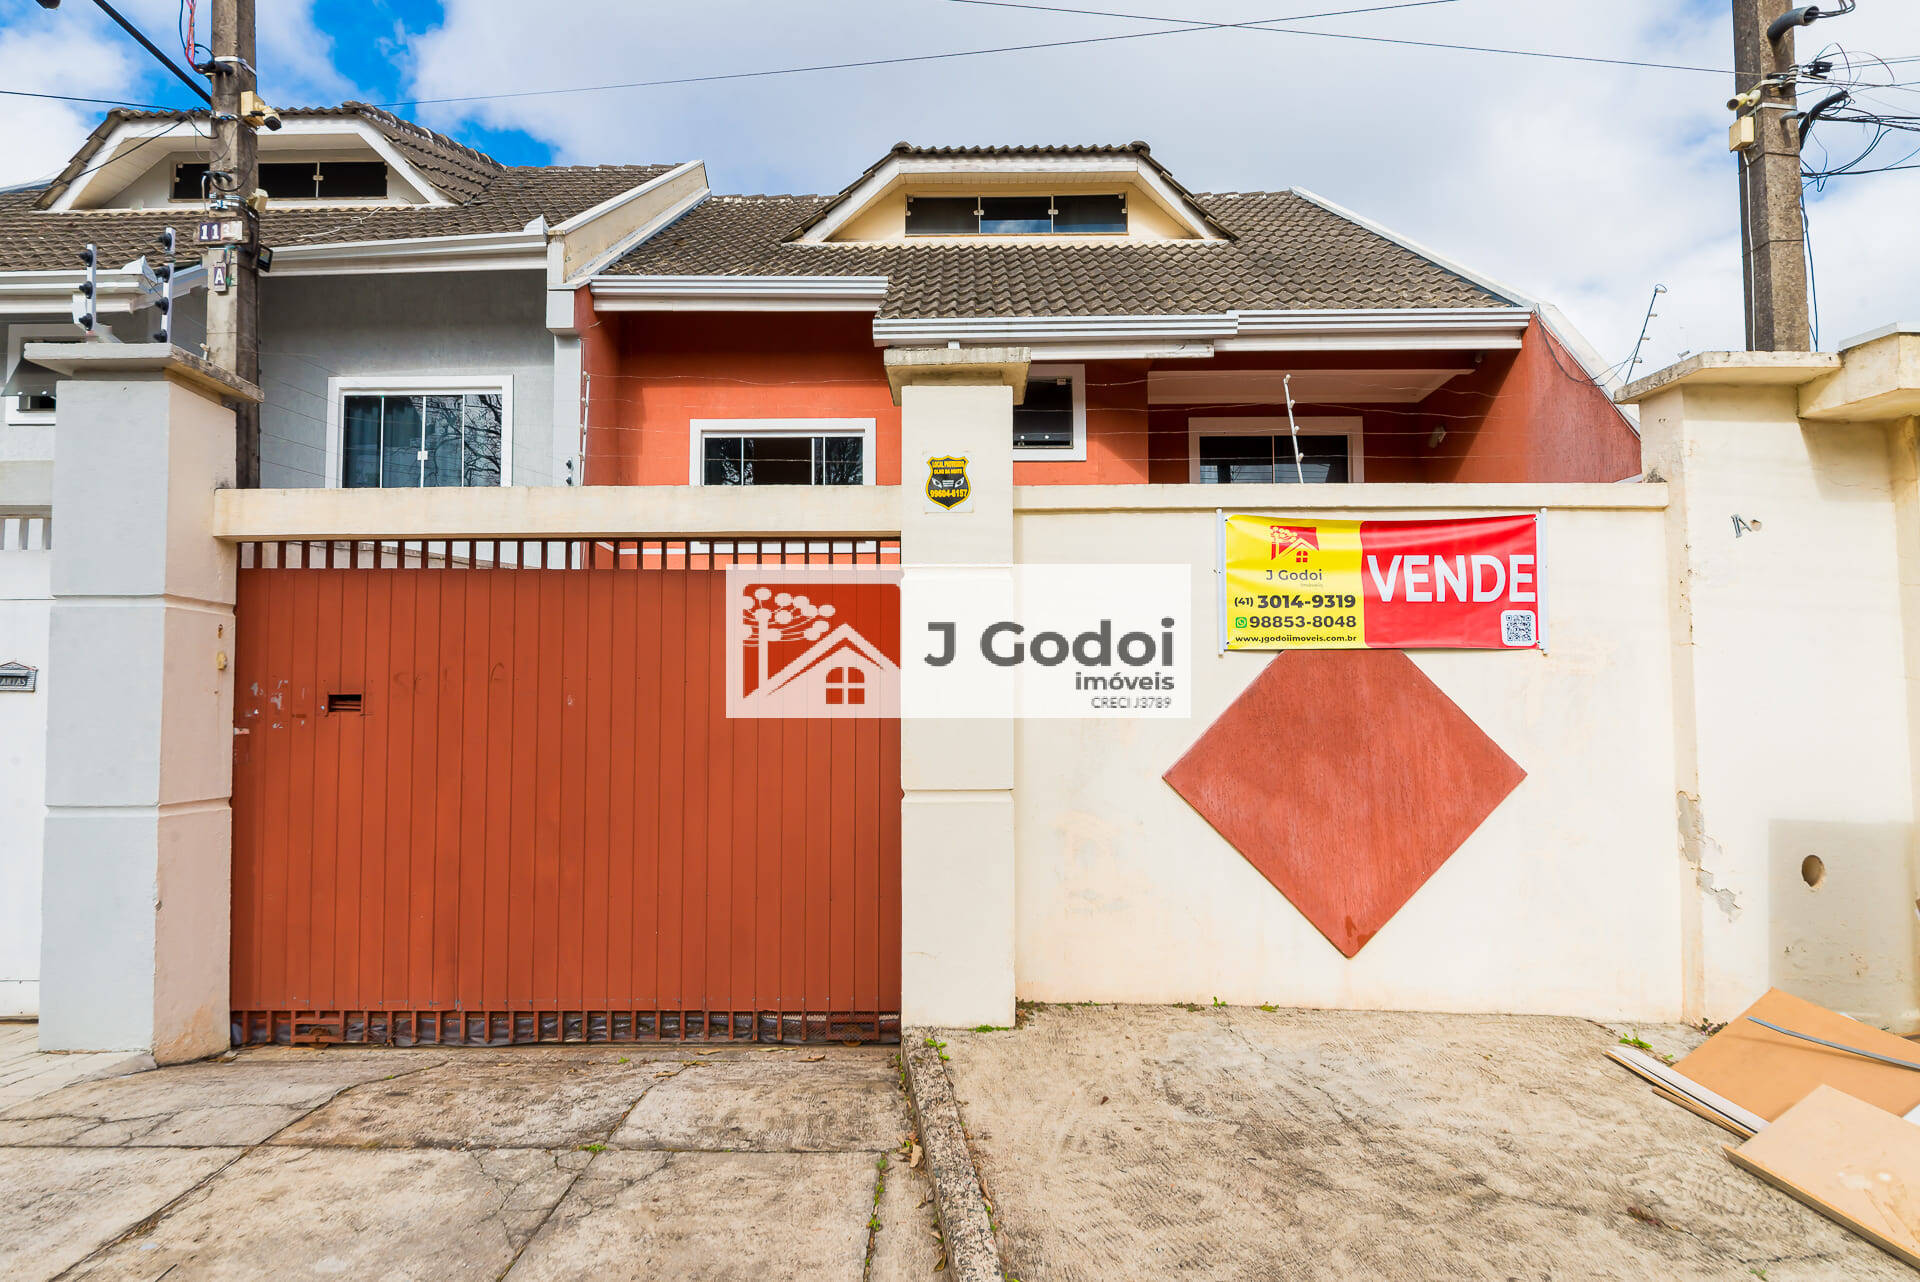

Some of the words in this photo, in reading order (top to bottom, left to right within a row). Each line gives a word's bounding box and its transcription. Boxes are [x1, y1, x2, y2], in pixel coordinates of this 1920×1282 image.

[1266, 570, 1273, 581] J
[1278, 569, 1323, 581] Godoi
[1367, 555, 1536, 602] VENDE
[1234, 597, 1254, 607] (41)
[1257, 595, 1356, 609] 3014-9319
[1249, 616, 1357, 628] 98853-8048
[1235, 635, 1357, 643] www.jgodoiimoveis.com.br
